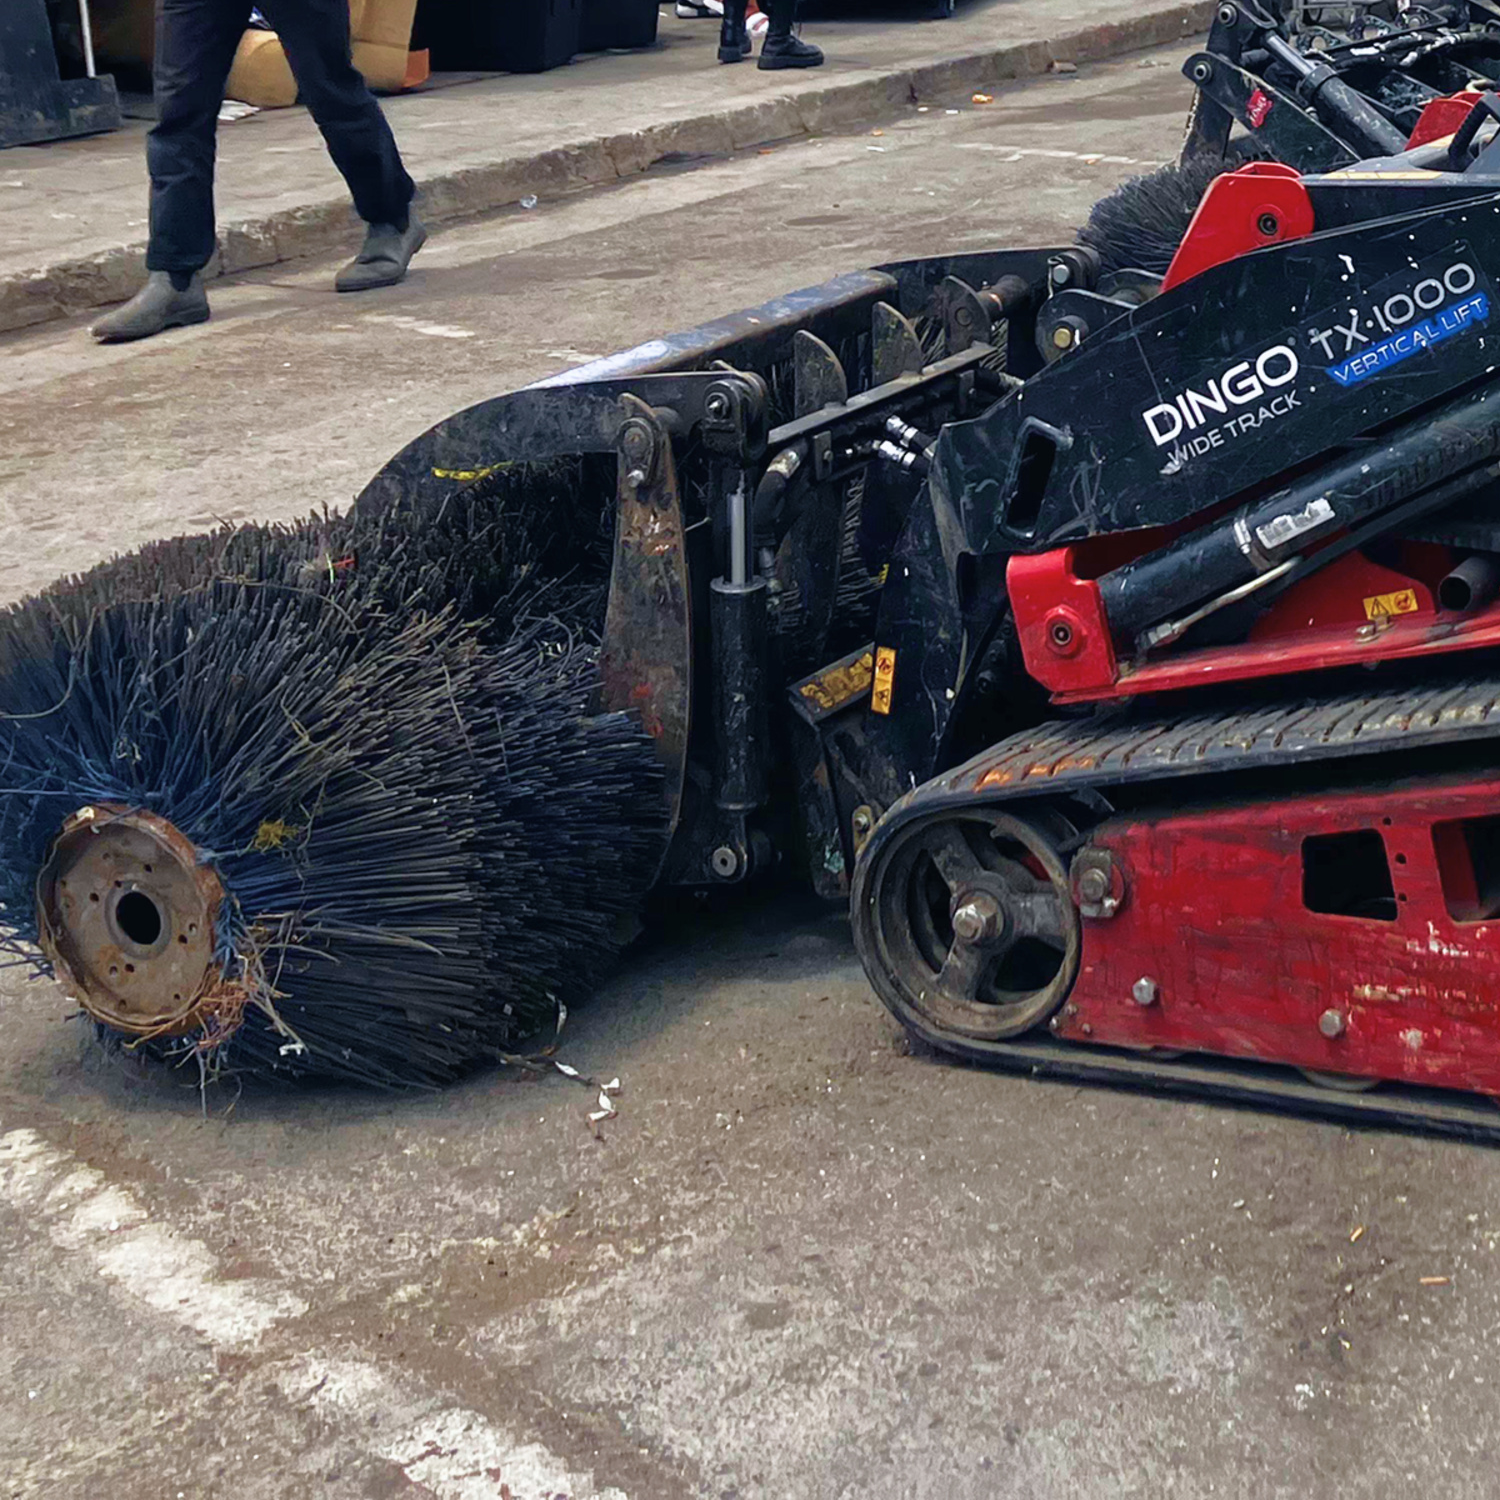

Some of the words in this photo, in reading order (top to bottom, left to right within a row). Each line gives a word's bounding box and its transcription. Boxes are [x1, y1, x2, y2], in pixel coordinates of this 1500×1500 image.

[1333, 325, 1441, 383] VERTICAL
[1441, 297, 1486, 331] LIFT
[1143, 344, 1300, 447] DINGO
[1167, 427, 1226, 467] WIDE
[1223, 389, 1302, 438] TRACK
